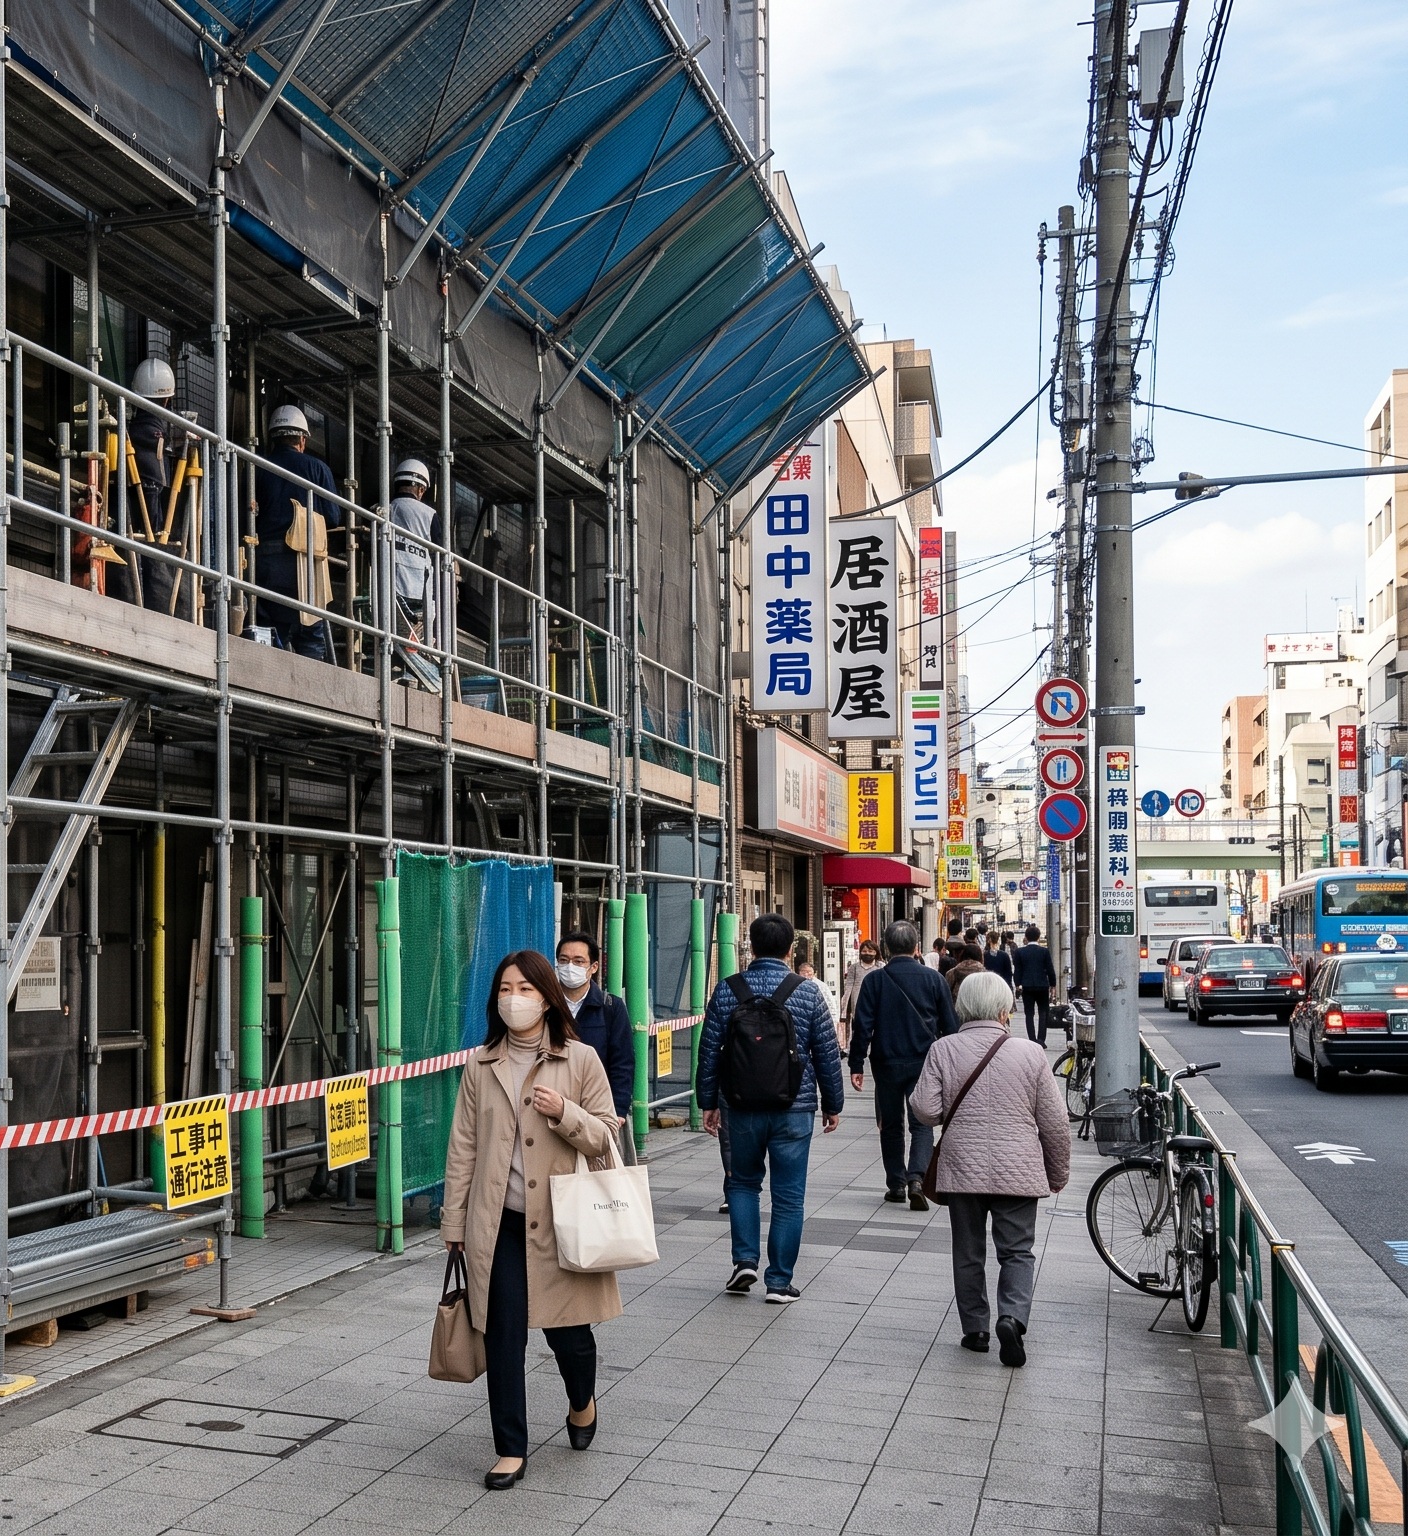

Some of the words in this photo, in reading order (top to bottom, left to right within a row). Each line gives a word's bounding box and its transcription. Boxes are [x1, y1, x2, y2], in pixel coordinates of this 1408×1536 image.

[765, 493, 813, 697] 田中薬局
[829, 535, 891, 722] 居酒屋
[169, 1154, 228, 1199] 通行注意
[170, 1118, 223, 1160] 工事中
